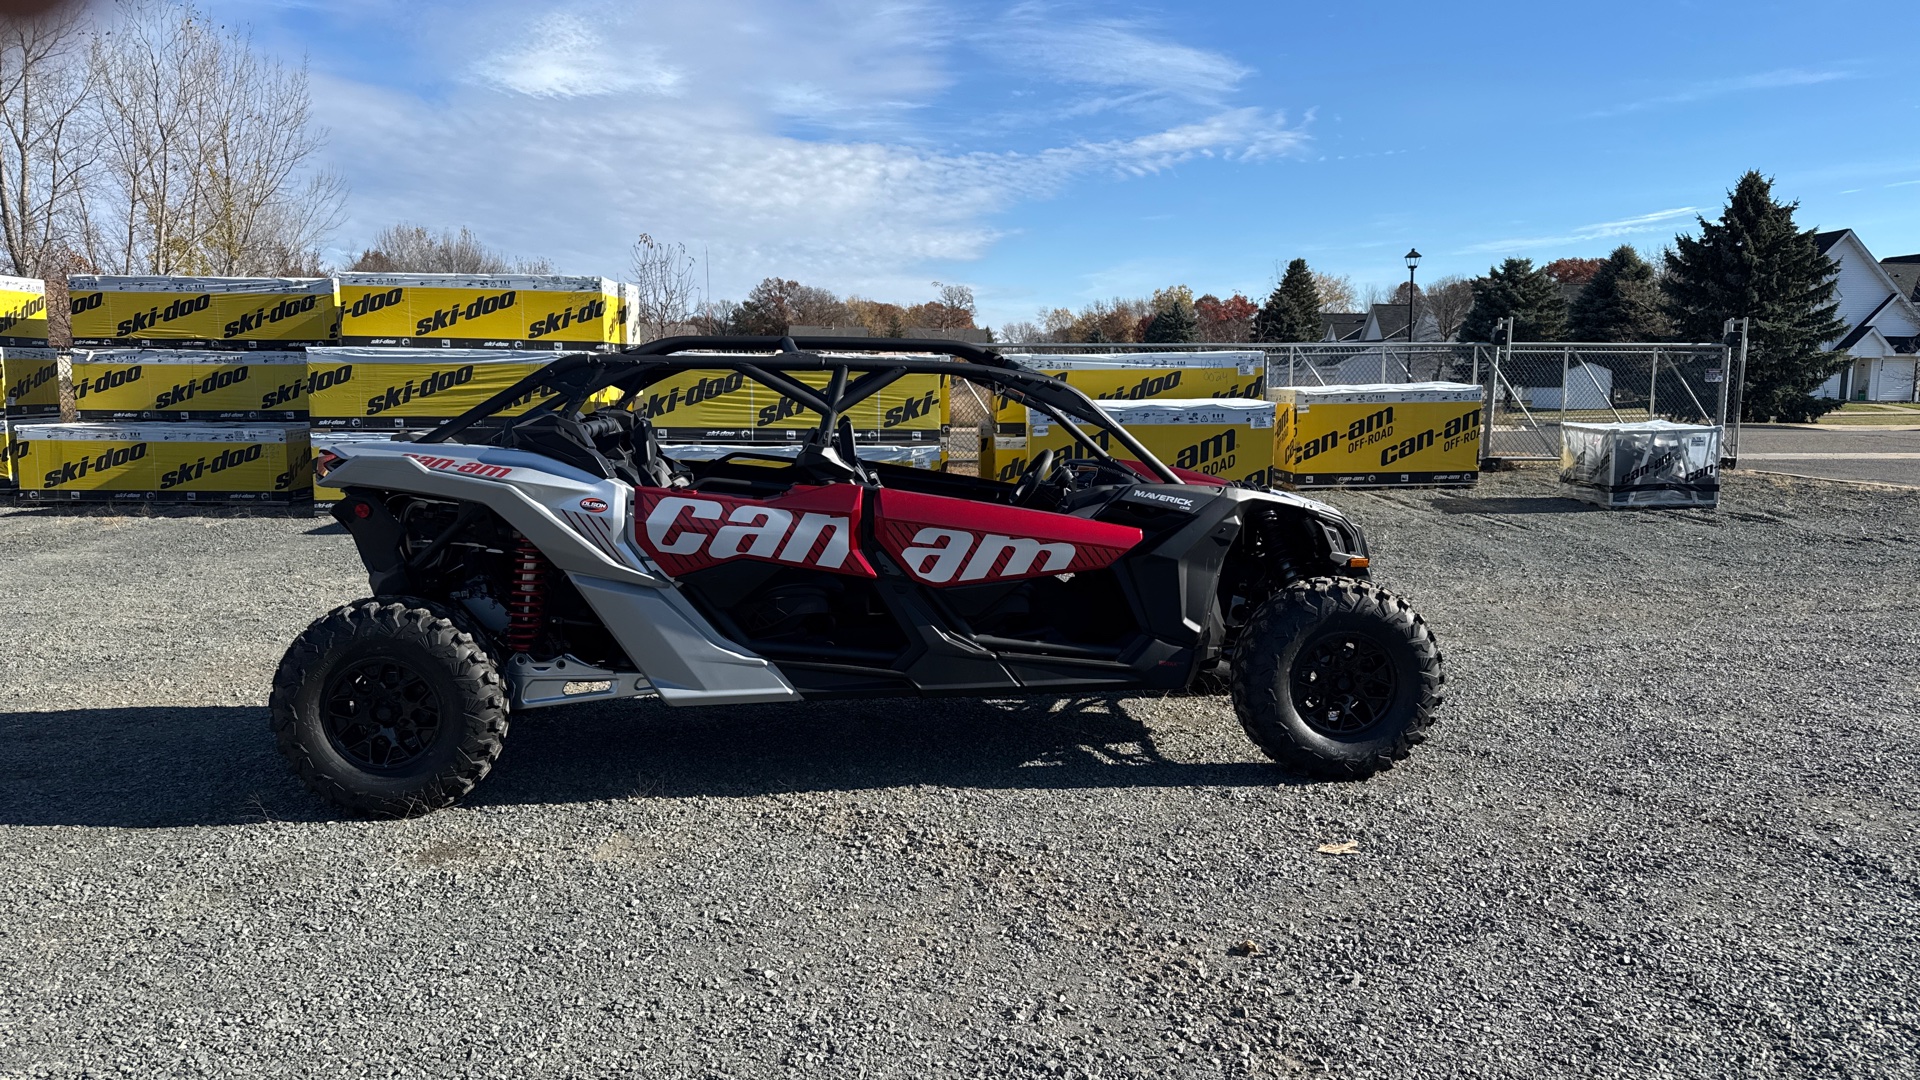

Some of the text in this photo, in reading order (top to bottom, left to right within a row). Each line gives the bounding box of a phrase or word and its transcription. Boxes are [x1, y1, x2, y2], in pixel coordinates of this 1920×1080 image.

[116, 294, 210, 336] ski-doo
[224, 295, 316, 338] ski-doo
[340, 288, 402, 321] i-doo
[416, 291, 516, 336] ski-doo
[529, 299, 606, 339] ski-do
[73, 366, 142, 400] i-doo
[155, 366, 249, 409] ski-doo
[366, 365, 473, 415] ski-doo
[643, 372, 743, 419] ki-doo
[1098, 371, 1181, 399] i-doo
[884, 390, 939, 428] ski-
[1348, 426, 1393, 453] OFF-ROAD
[1444, 426, 1480, 452] OFF-ROA
[44, 442, 148, 488] ski-doo
[161, 444, 262, 489] ski-doo
[1203, 454, 1235, 475] ROAD
[1134, 490, 1193, 506] MAVERICK
[646, 497, 1076, 583] can am
